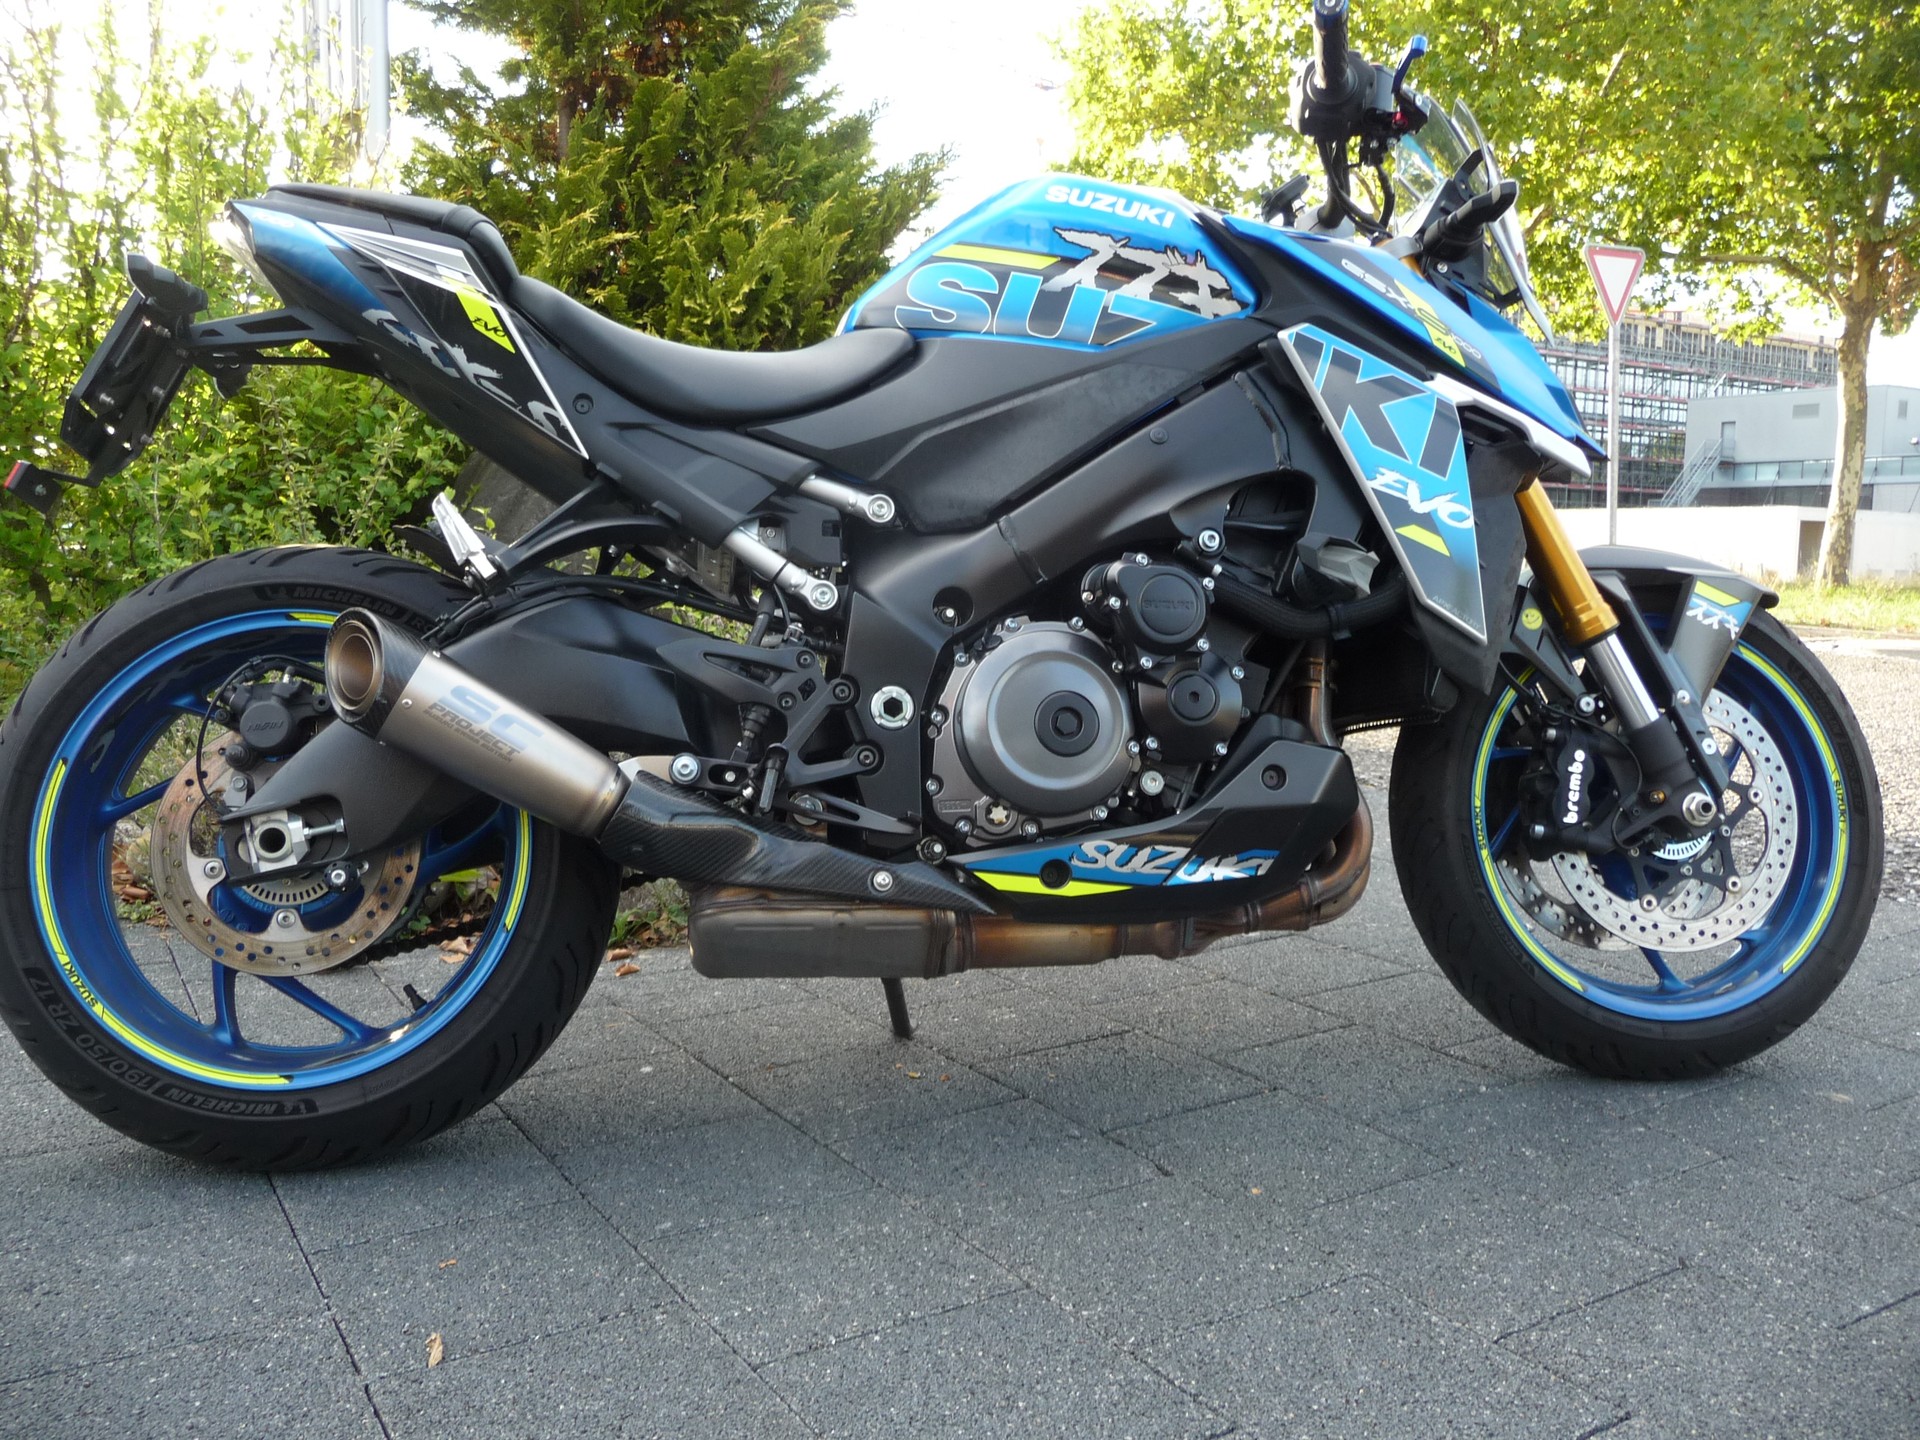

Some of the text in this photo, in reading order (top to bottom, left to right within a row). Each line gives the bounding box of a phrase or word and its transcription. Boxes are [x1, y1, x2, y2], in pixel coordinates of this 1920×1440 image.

[1044, 184, 1175, 229] SUZUKI
[471, 315, 507, 338] EVO
[1367, 467, 1475, 529] EVO
[293, 585, 399, 616] MICHELIN
[428, 702, 521, 757] PROJECT
[437, 685, 545, 752] SC
[1562, 749, 1586, 824] brembo
[1833, 779, 1847, 823] SUZUKI
[1474, 806, 1487, 851] SUZUKI
[62, 961, 98, 1008] SUZUKI
[29, 977, 279, 1115] MICHELIN 190/50 ZR 17
